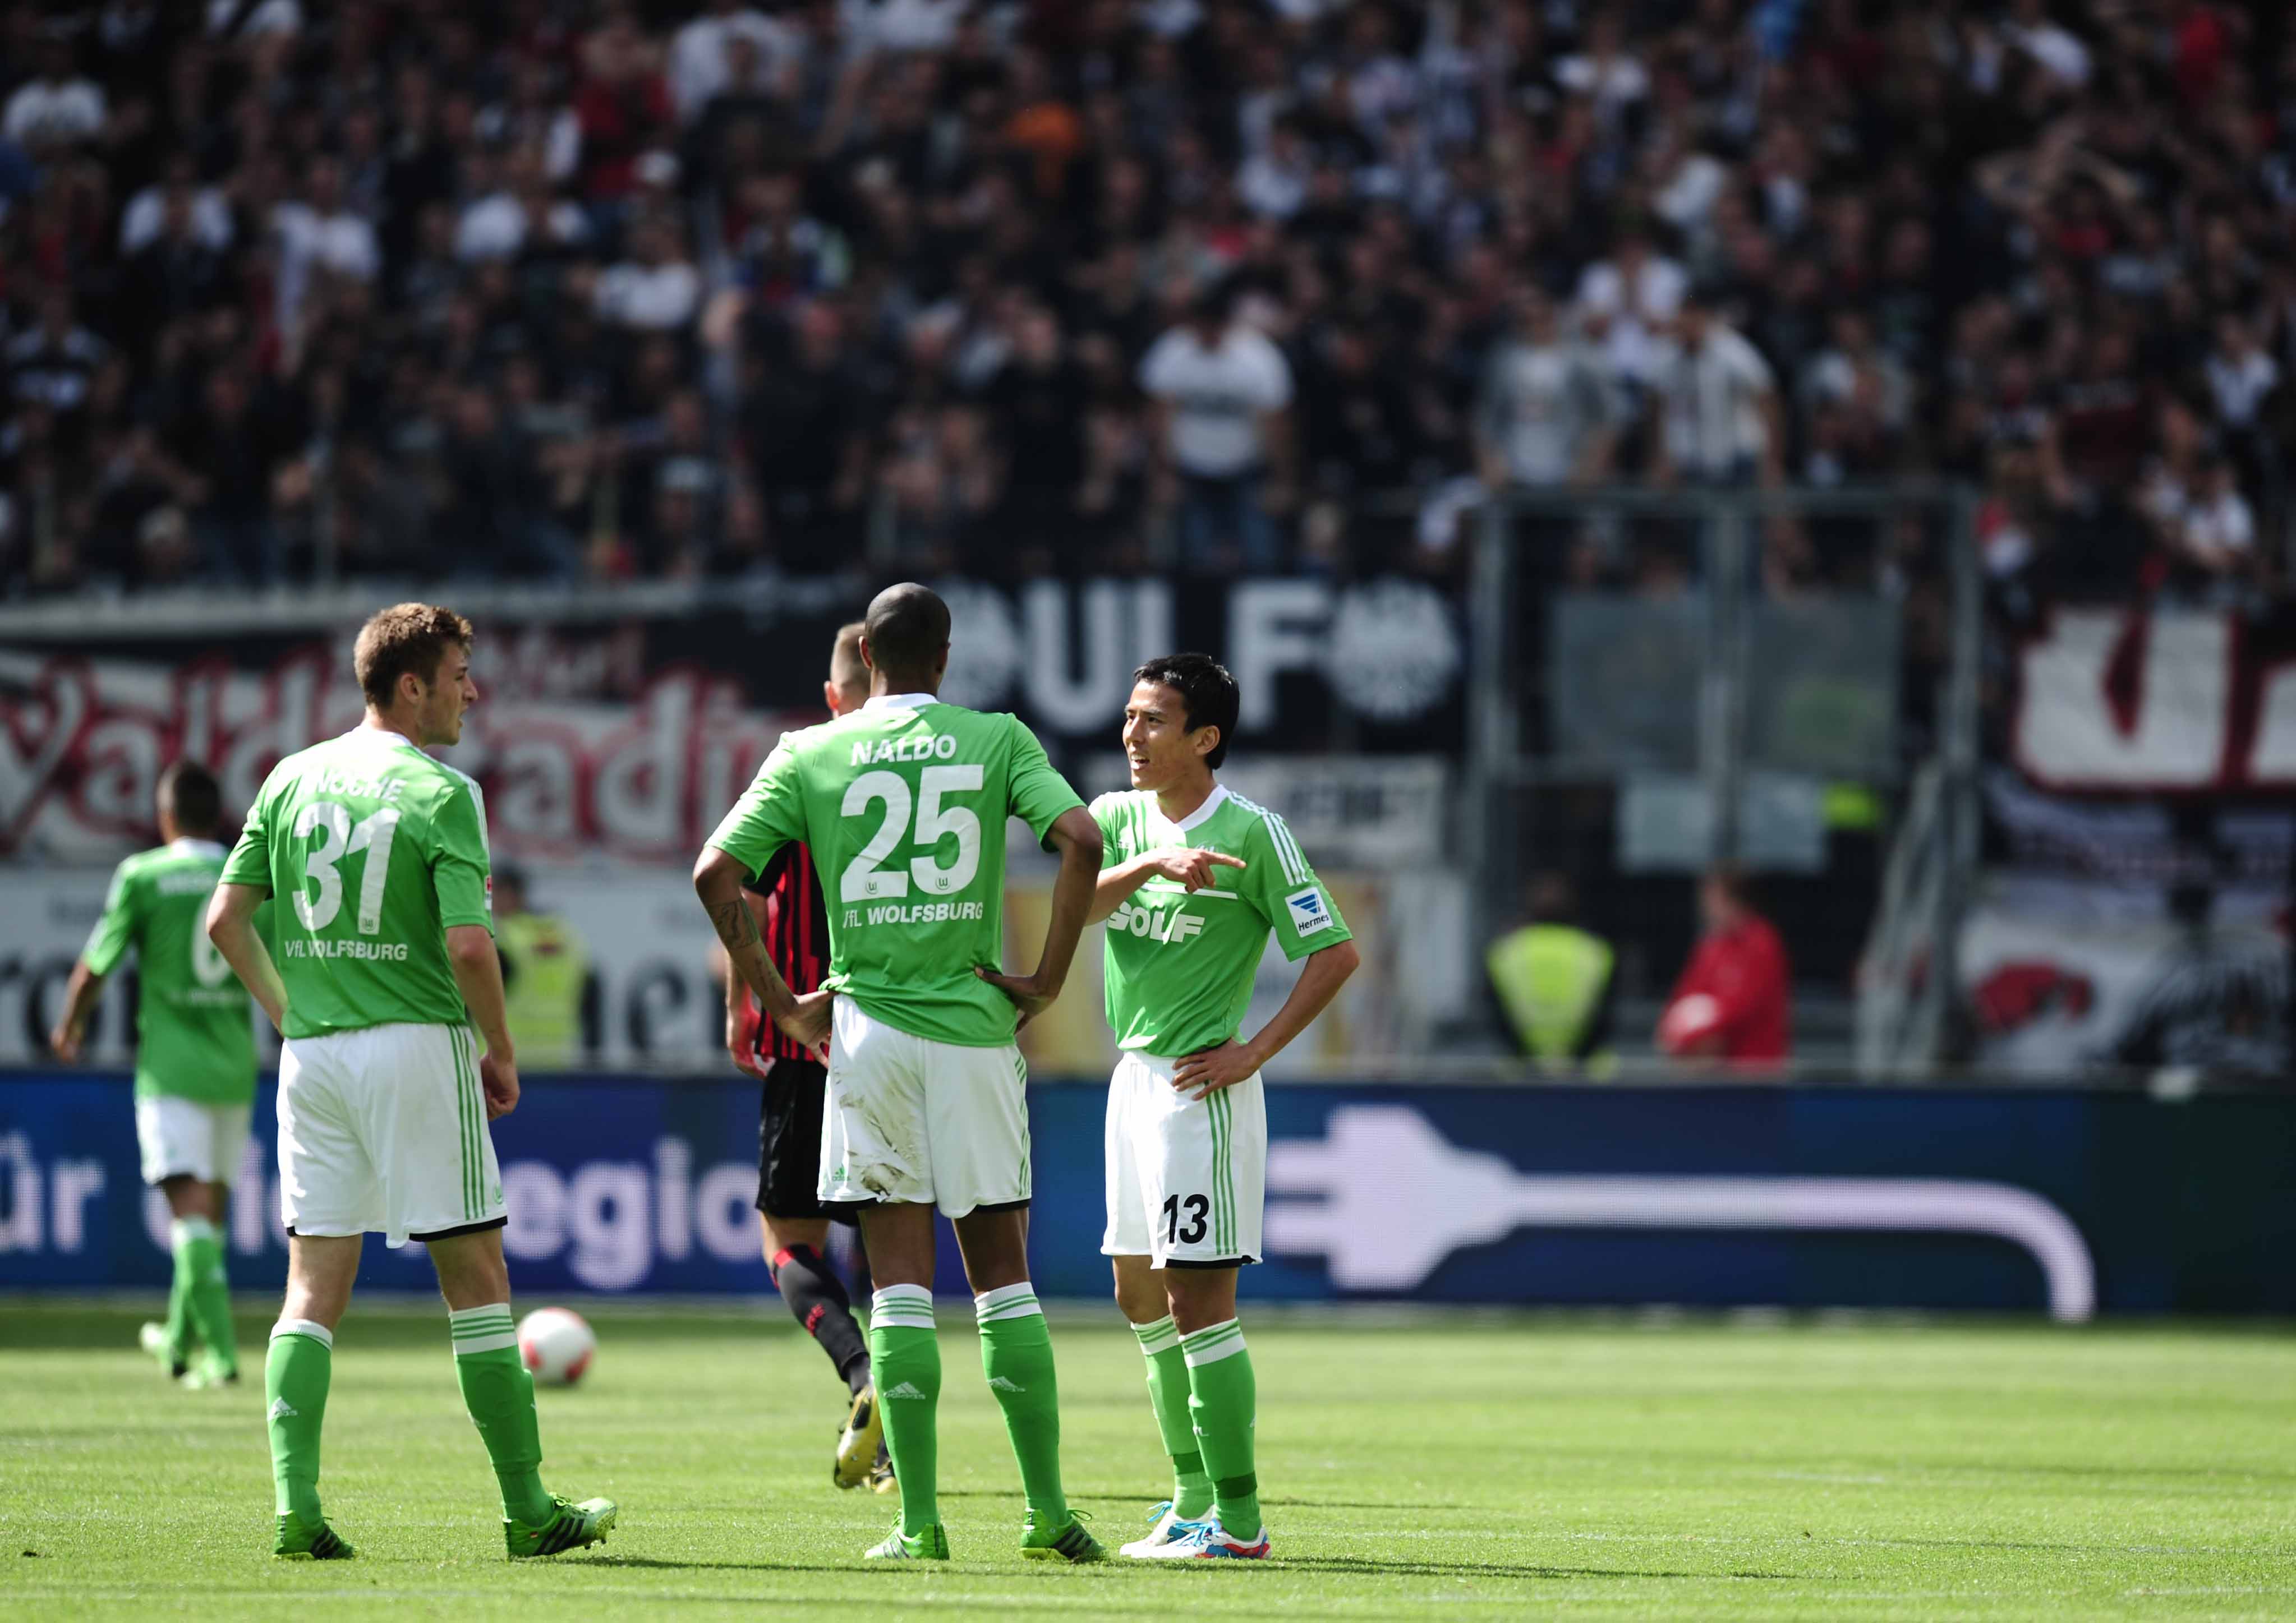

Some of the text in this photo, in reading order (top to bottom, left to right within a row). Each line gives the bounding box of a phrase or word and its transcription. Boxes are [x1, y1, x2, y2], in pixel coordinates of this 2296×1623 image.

[850, 734, 957, 767] NALDO
[840, 764, 984, 903] 25
[292, 801, 402, 936] 31
[867, 901, 984, 926] WOLFSBURG
[1298, 914, 1329, 932] Hermes
[284, 940, 306, 958] VfL
[500, 1134, 855, 1291] egio
[1163, 1193, 1210, 1244] 13
